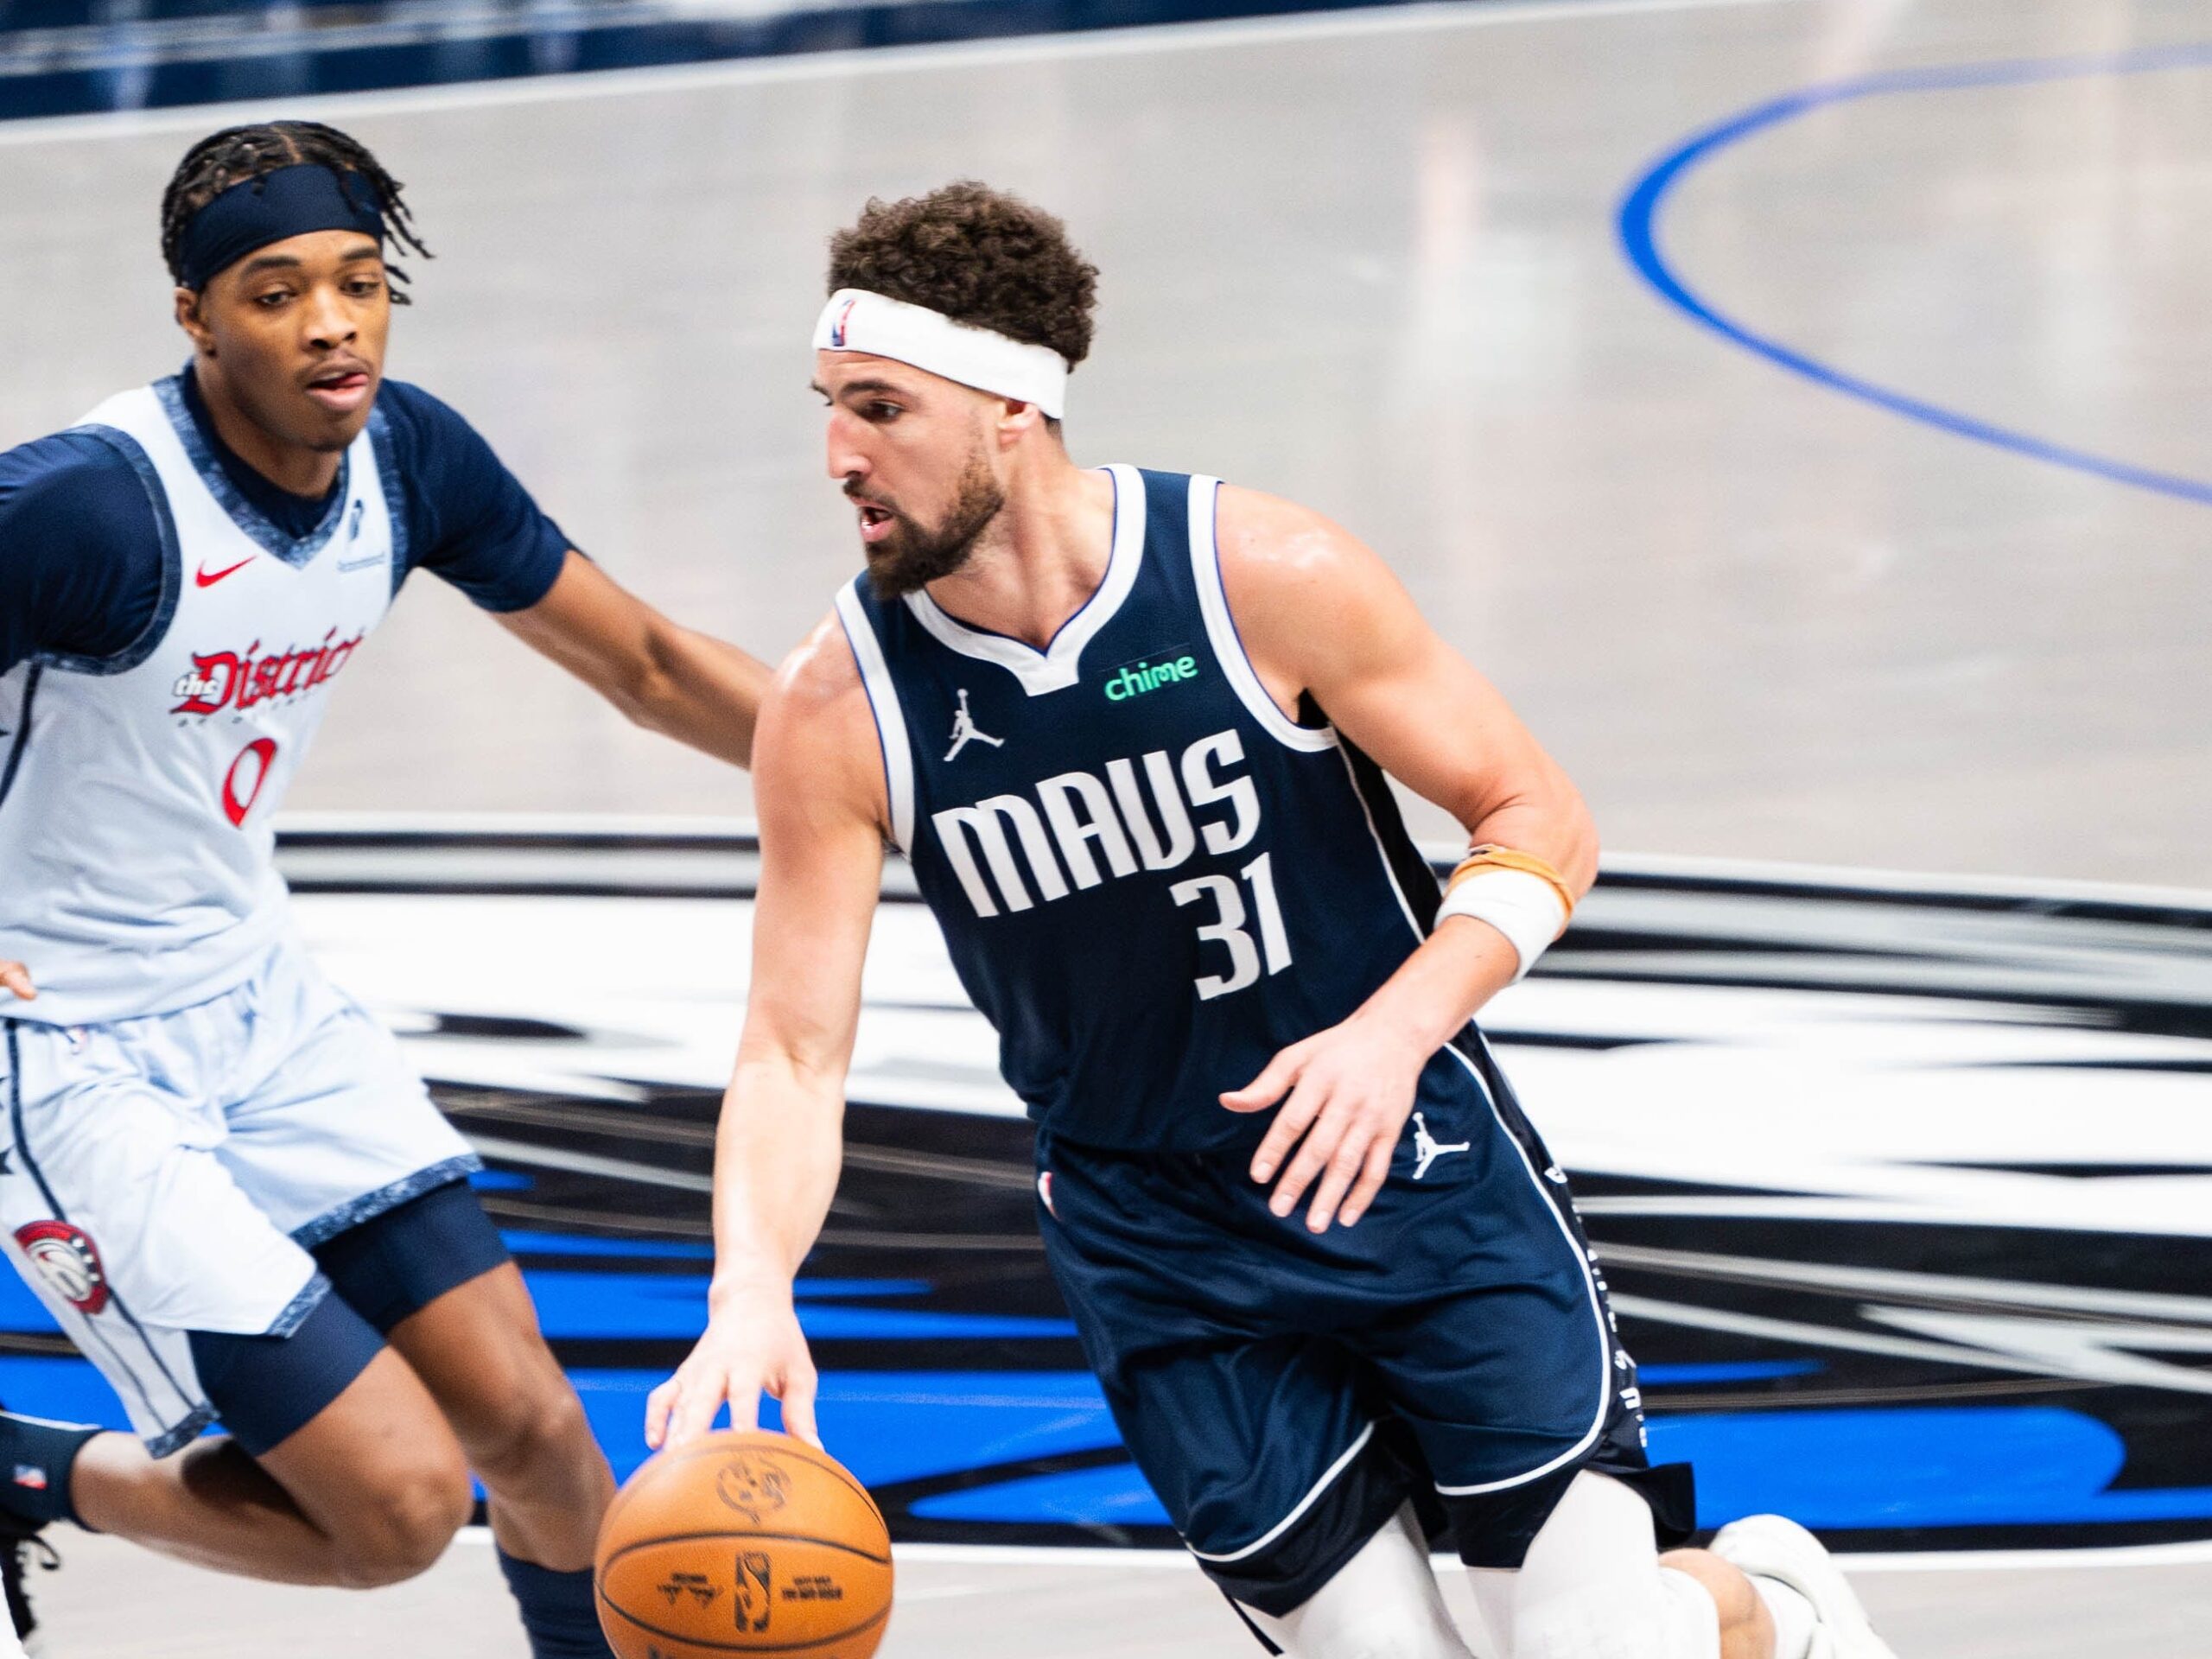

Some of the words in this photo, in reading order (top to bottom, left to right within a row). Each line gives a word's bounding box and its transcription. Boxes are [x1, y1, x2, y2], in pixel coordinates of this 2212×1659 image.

[172, 672, 219, 697] the
[1104, 655, 1198, 702] chime
[221, 738, 278, 829] 0
[1169, 852, 1294, 1002] 31
